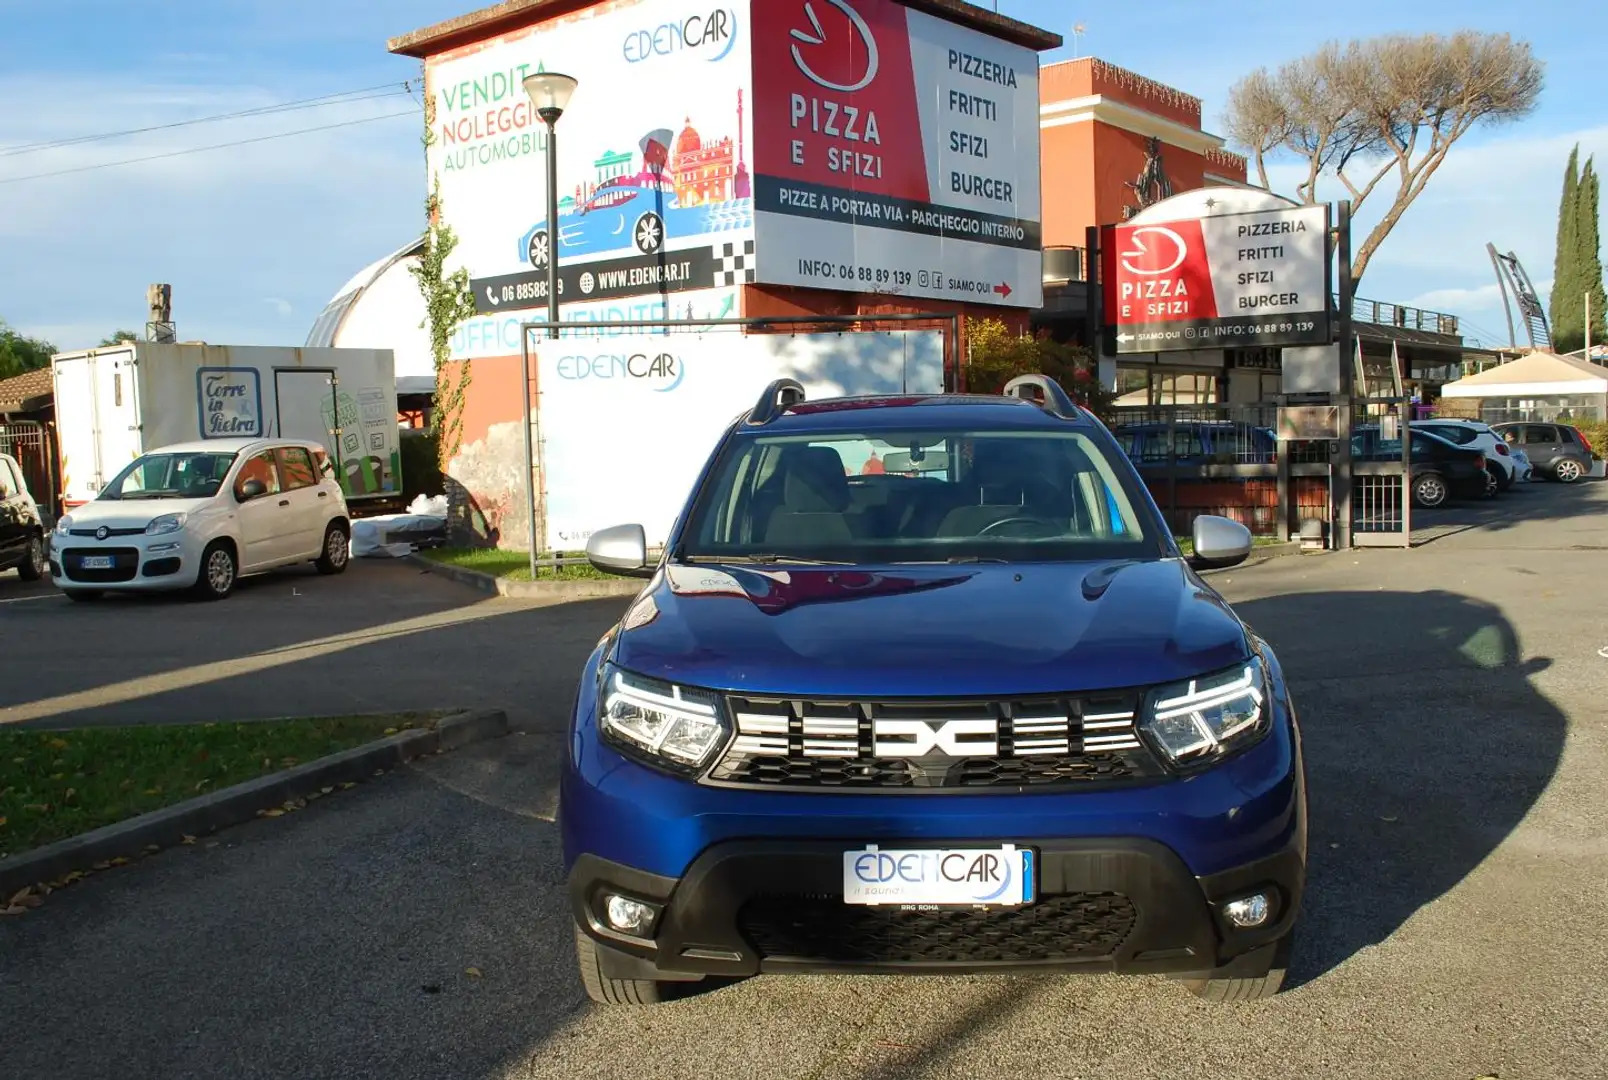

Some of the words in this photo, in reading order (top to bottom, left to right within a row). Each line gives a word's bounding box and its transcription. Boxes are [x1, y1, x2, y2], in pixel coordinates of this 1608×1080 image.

[623, 8, 729, 63] EDENCAR
[948, 49, 1018, 89] PIZZERIA
[949, 89, 997, 122] FRITTI
[790, 93, 881, 145] PIZZA
[444, 130, 547, 173] AUTOMOBIL
[949, 130, 989, 159] SFIZI
[791, 140, 804, 165] E
[828, 147, 882, 179] SFIZI
[951, 171, 1013, 203] BURGER
[780, 187, 817, 209] PIZZE
[820, 195, 829, 212] A
[832, 196, 881, 218] PORTAR
[883, 204, 903, 222] VIA
[911, 209, 980, 234] PARCHEGGIO
[981, 221, 1024, 241] INTERNO
[1238, 219, 1306, 238] PIZZERIA
[1238, 246, 1284, 261] FRITTI
[598, 262, 690, 290] WWW.EDENCAR.IT
[799, 259, 836, 278] INFO:
[839, 265, 854, 280] 06
[858, 267, 872, 282] 88
[876, 269, 890, 284] 89
[893, 271, 911, 286] 139
[949, 278, 976, 292] SIAMO
[976, 280, 991, 294] QUI
[1238, 270, 1274, 285] SFIZI
[502, 286, 515, 302] 06
[516, 278, 563, 300] 885889
[1122, 279, 1188, 300] PIZZA
[1238, 292, 1299, 309] BURGER
[1122, 305, 1131, 317] E
[1148, 301, 1188, 315] SFIZI
[1138, 331, 1164, 340] SIAMO
[1214, 326, 1245, 336] INFO:
[1248, 325, 1261, 334] 06
[1264, 324, 1277, 333] 88
[1280, 323, 1293, 332] 89
[1296, 321, 1314, 331] 139
[557, 354, 676, 379] EDENCAR
[206, 376, 246, 398] Torre
[208, 398, 223, 412] in
[210, 413, 255, 433] Pietra
[855, 853, 1000, 882] EDENCAR
[901, 904, 916, 912] RRG
[918, 904, 939, 912] ROMA
